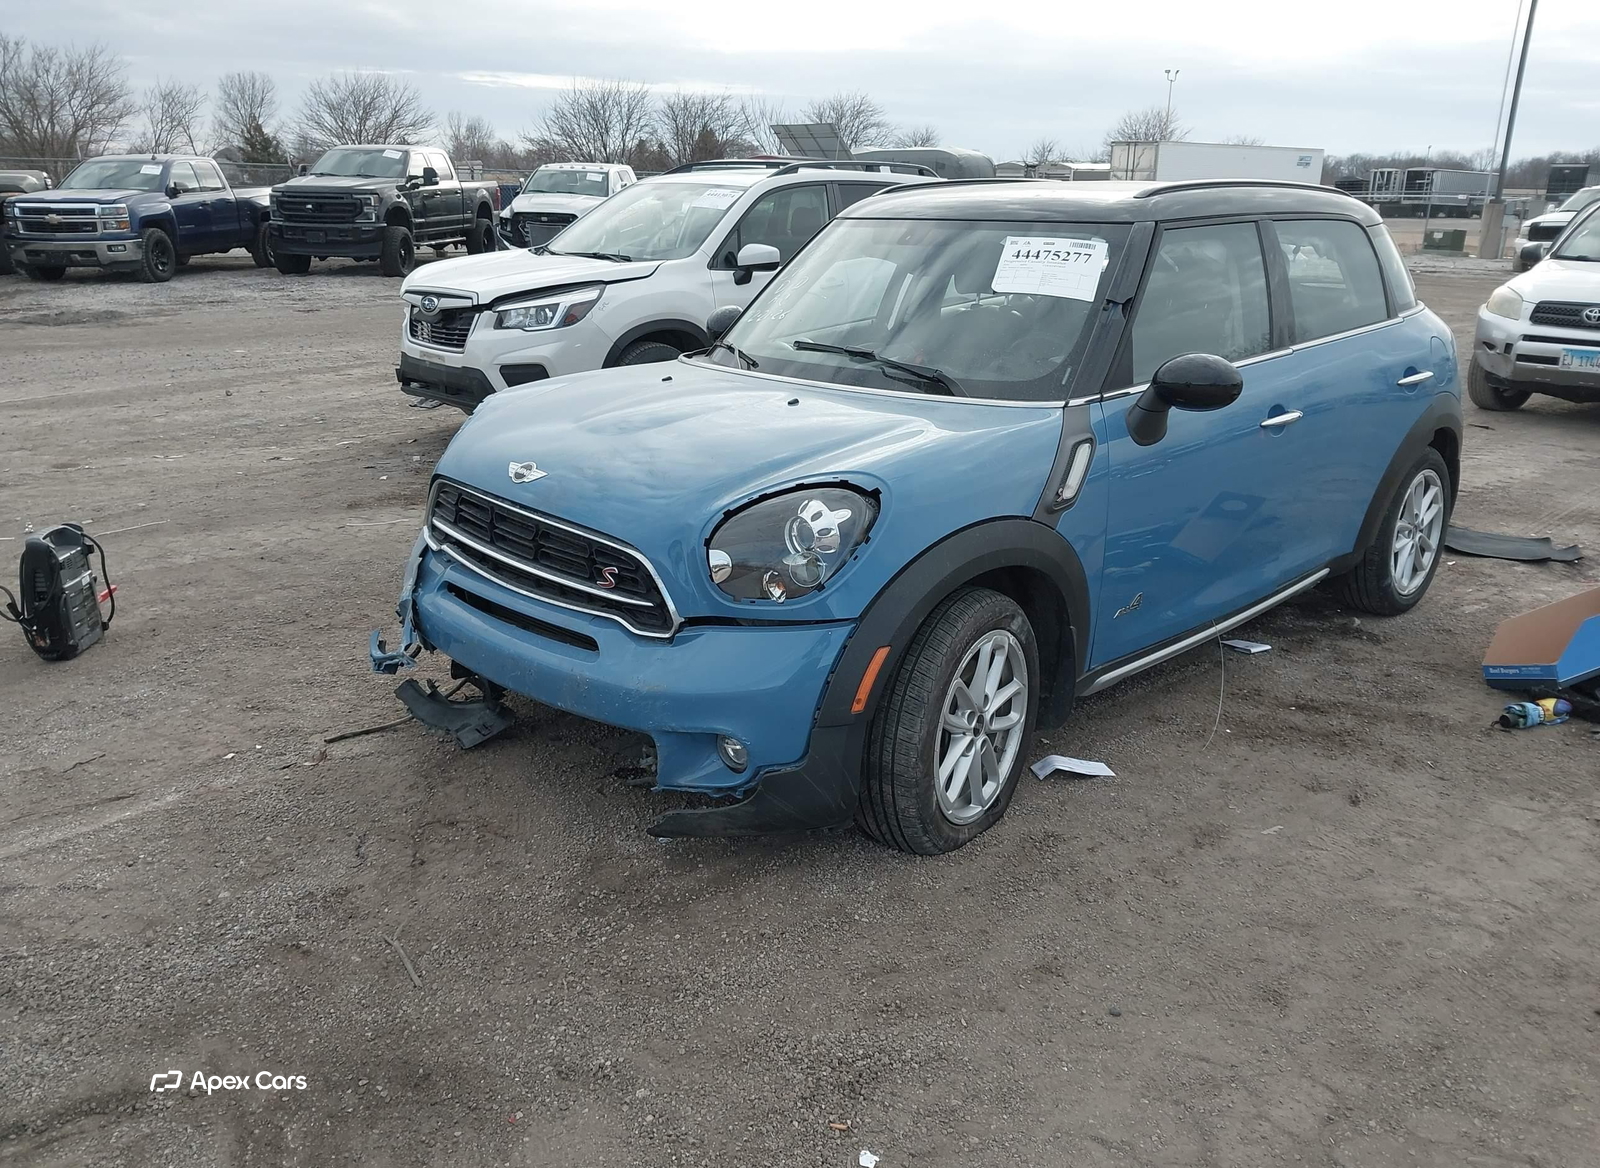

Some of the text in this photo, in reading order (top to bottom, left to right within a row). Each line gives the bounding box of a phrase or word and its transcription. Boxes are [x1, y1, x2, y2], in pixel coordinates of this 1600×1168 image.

[1011, 249, 1093, 264] 44475277
[1562, 354, 1575, 366] EJ
[596, 566, 619, 589] S
